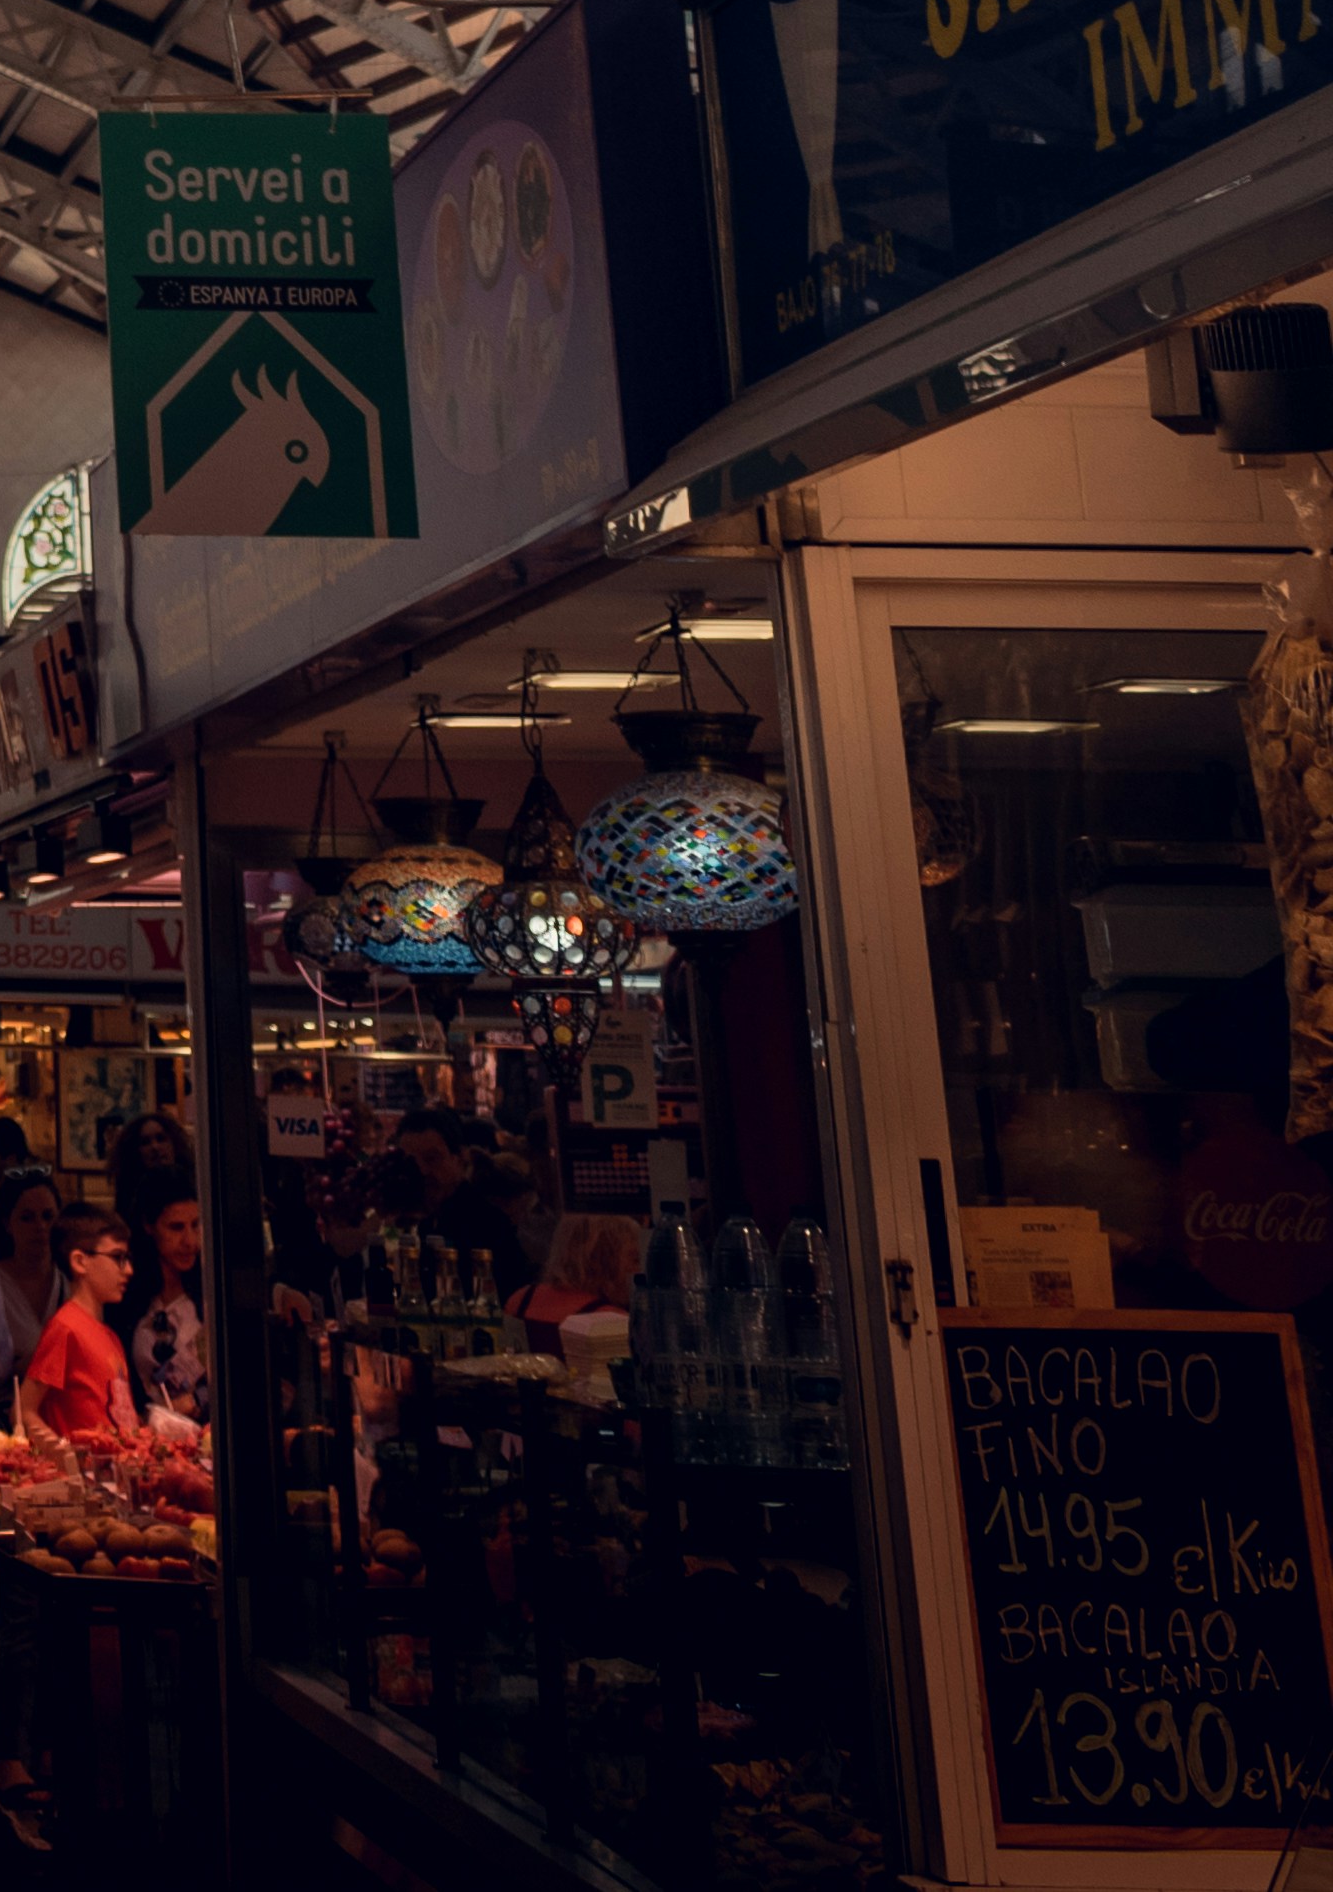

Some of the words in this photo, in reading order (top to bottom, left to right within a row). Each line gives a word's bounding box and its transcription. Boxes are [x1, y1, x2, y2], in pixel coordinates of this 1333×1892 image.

[143, 148, 304, 205] Servei
[322, 166, 350, 204] a
[147, 213, 357, 268] domicili
[189, 284, 269, 307] ESPANYA
[272, 288, 284, 307] I
[287, 286, 359, 308] EUROPA
[775, 274, 817, 334] BAJO
[275, 1116, 321, 1138] VISA
[1021, 1222, 1057, 1233] EXTRA
[957, 1345, 1222, 1424] BACALAO
[961, 1413, 1107, 1484] FINO
[997, 1600, 1240, 1665] BACALAO
[1103, 1649, 1282, 1696] ISLANDIA
[1012, 1689, 1239, 1810] 13.90
